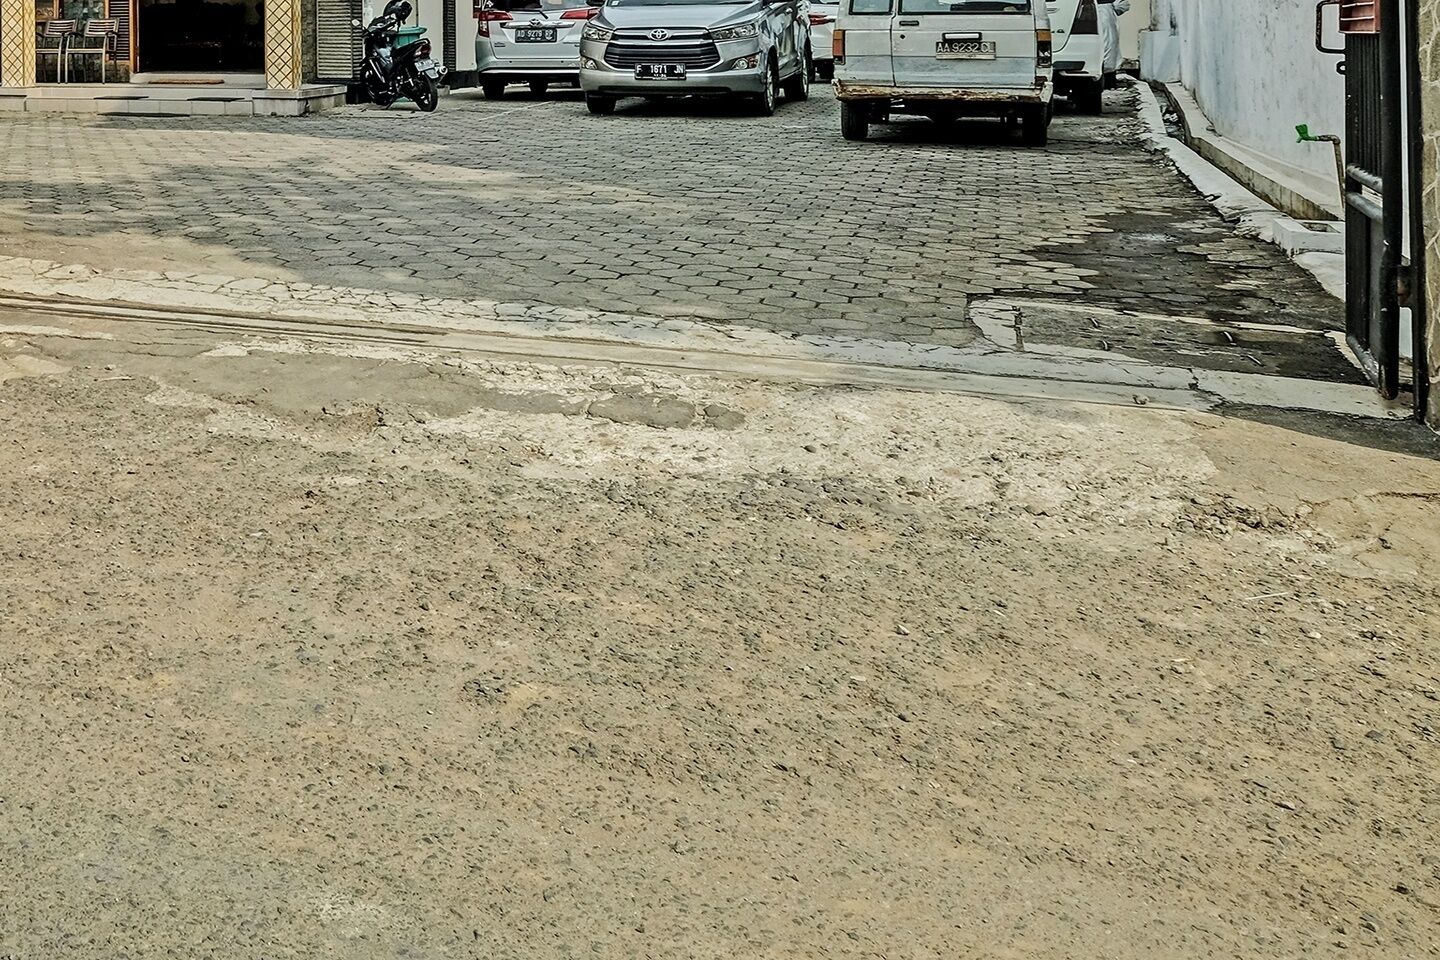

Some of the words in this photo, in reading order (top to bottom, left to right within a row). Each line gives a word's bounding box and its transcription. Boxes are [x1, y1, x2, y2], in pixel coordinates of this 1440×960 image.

[936, 42, 950, 53] AA
[951, 42, 979, 53] 9232
[650, 64, 667, 74] 1671
